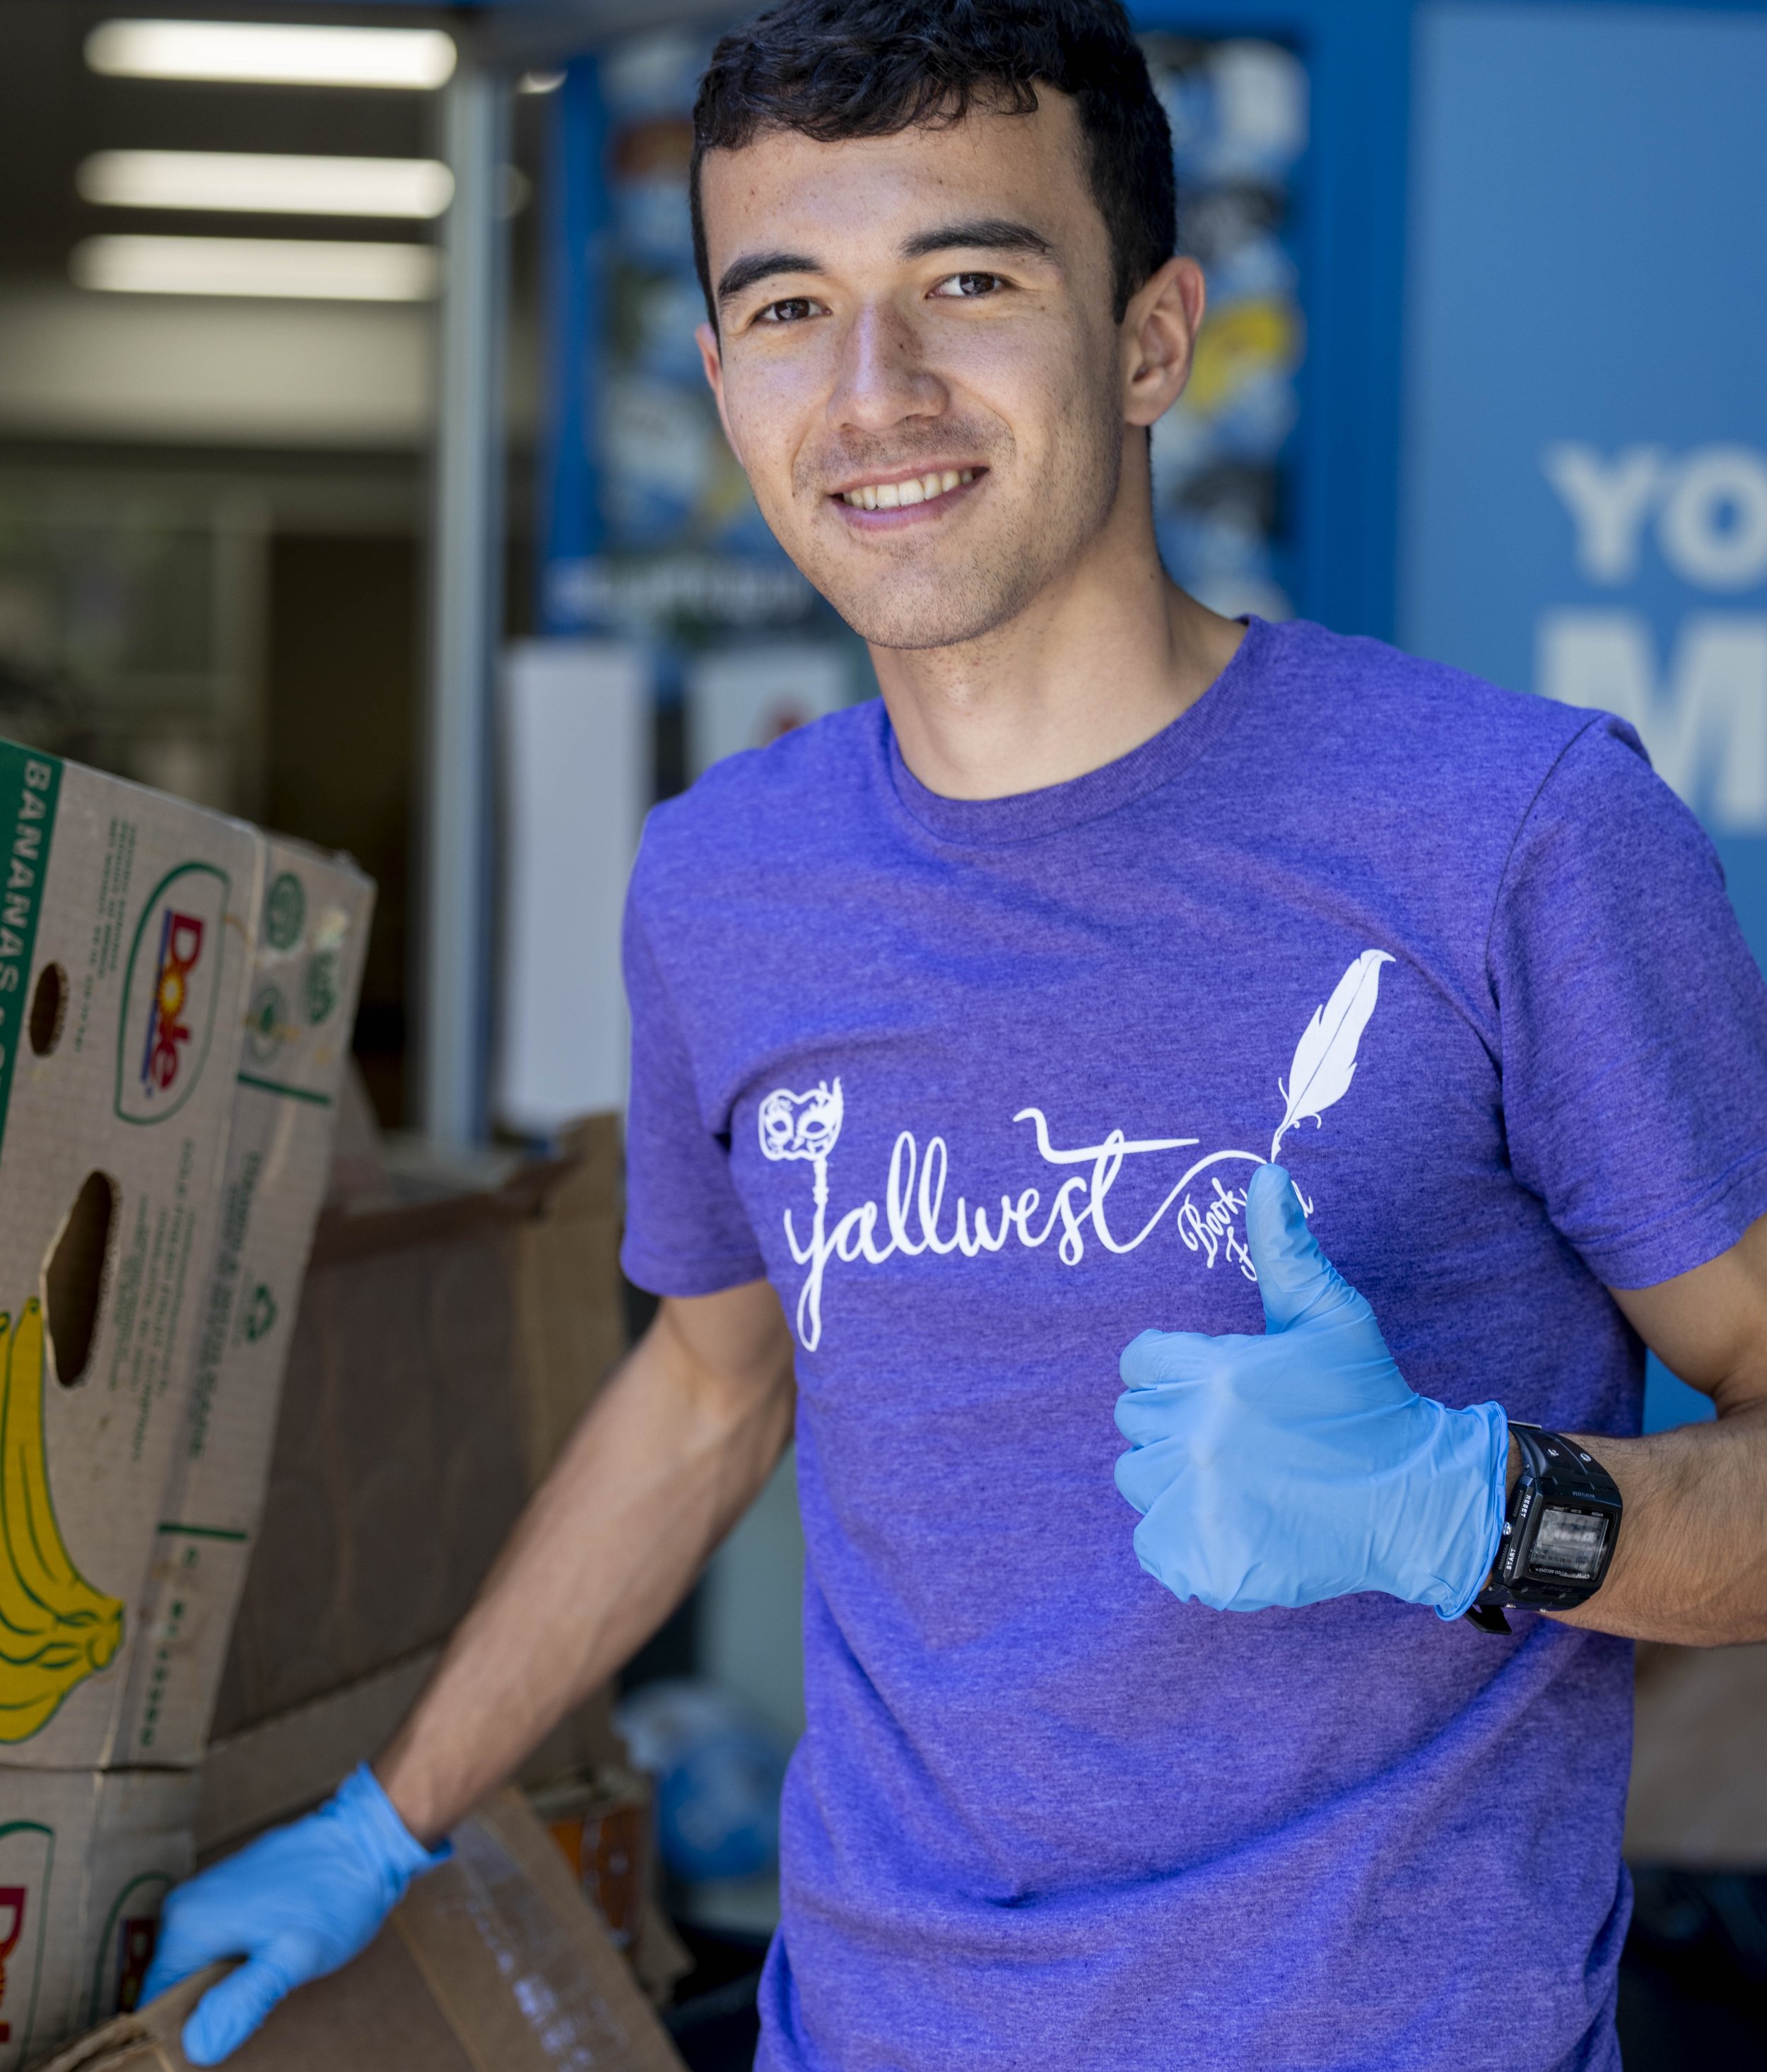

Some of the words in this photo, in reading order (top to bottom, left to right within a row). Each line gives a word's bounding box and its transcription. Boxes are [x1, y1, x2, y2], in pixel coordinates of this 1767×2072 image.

[0, 759, 52, 993] BANANAS
[150, 912, 203, 1091] Dole
[1178, 1177, 1247, 1268] Book
[1520, 1494, 1532, 1518] RESET
[1506, 1548, 1516, 1570] START
